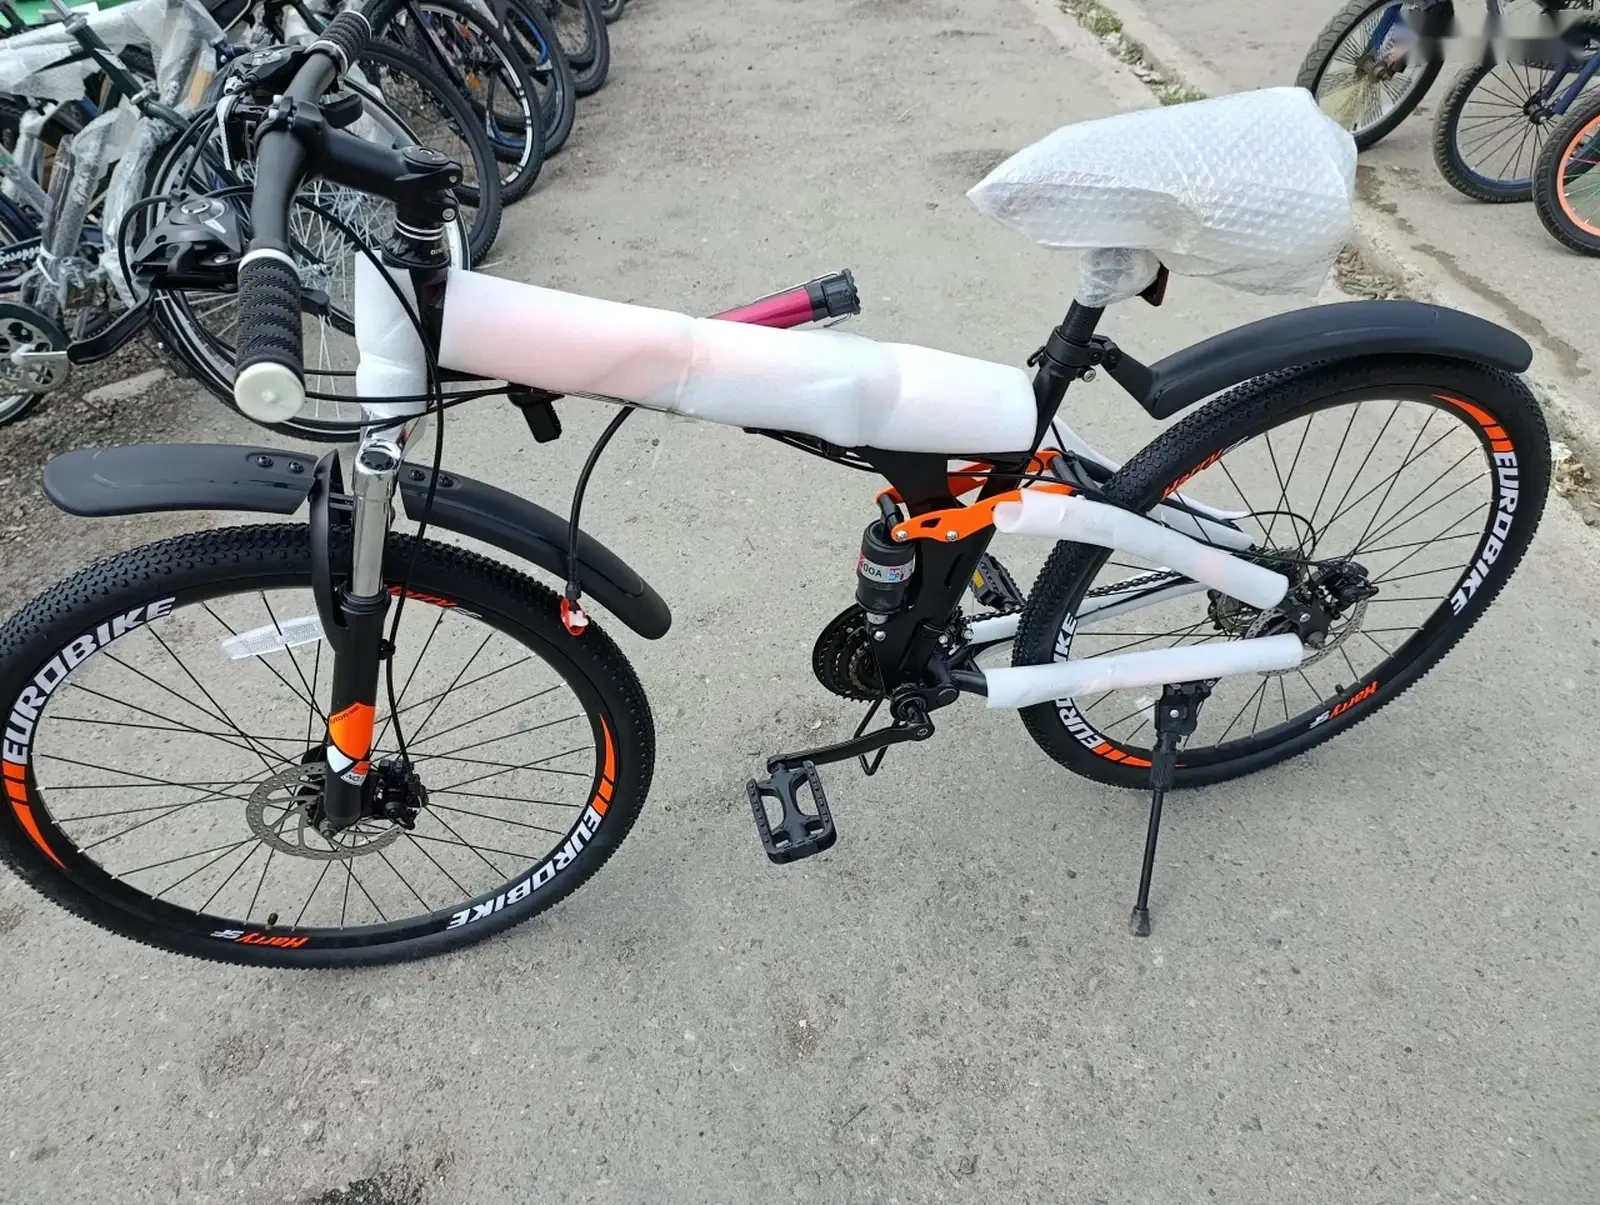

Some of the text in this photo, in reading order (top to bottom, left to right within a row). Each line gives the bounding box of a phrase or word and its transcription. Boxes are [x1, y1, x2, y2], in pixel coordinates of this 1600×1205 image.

[1450, 451, 1520, 616] EUROBIKE
[2, 596, 176, 765] EUROBIKE
[233, 932, 309, 948] Harry
[446, 805, 602, 930] EUROBIKE
